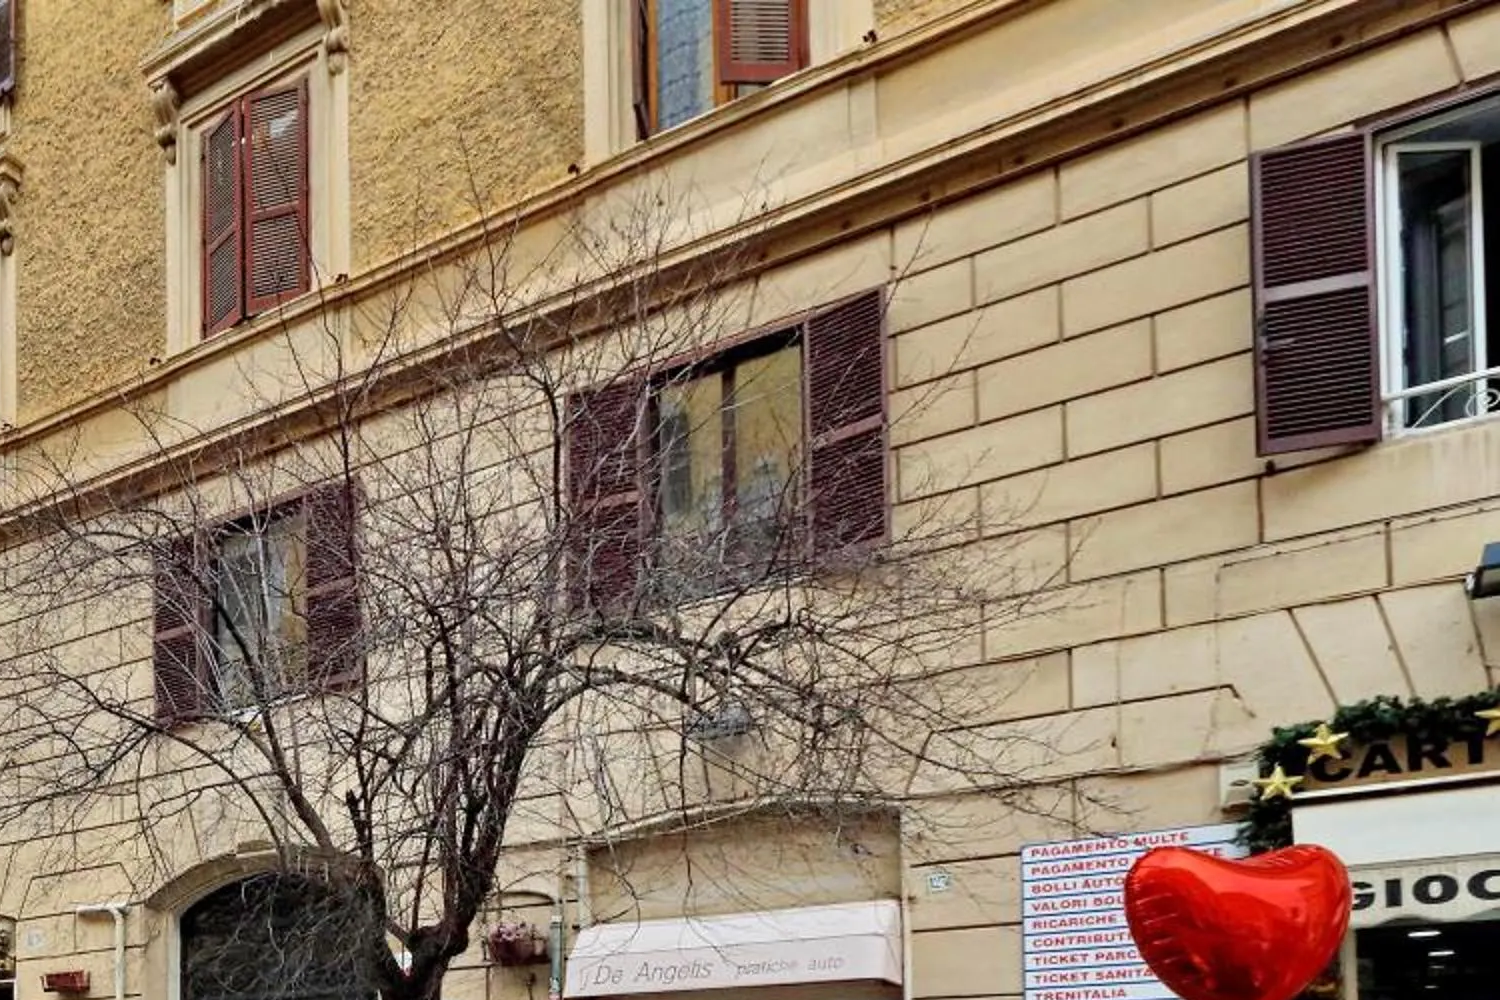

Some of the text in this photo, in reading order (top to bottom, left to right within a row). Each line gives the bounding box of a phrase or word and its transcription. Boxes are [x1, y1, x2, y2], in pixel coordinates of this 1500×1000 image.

[1031, 832, 1190, 858] PAGAMENTO MULTE
[1031, 857, 1129, 876] PAGAMENTO
[1031, 881, 1078, 895] BOLLI
[1032, 894, 1126, 912] VALORI BOL
[1032, 913, 1118, 930] RICARICHE
[1033, 949, 1143, 966] TICKET PARC
[592, 964, 624, 986] De
[634, 960, 715, 987] Angelis
[807, 956, 846, 971] auto
[1033, 966, 1155, 984] TICKET SANITA
